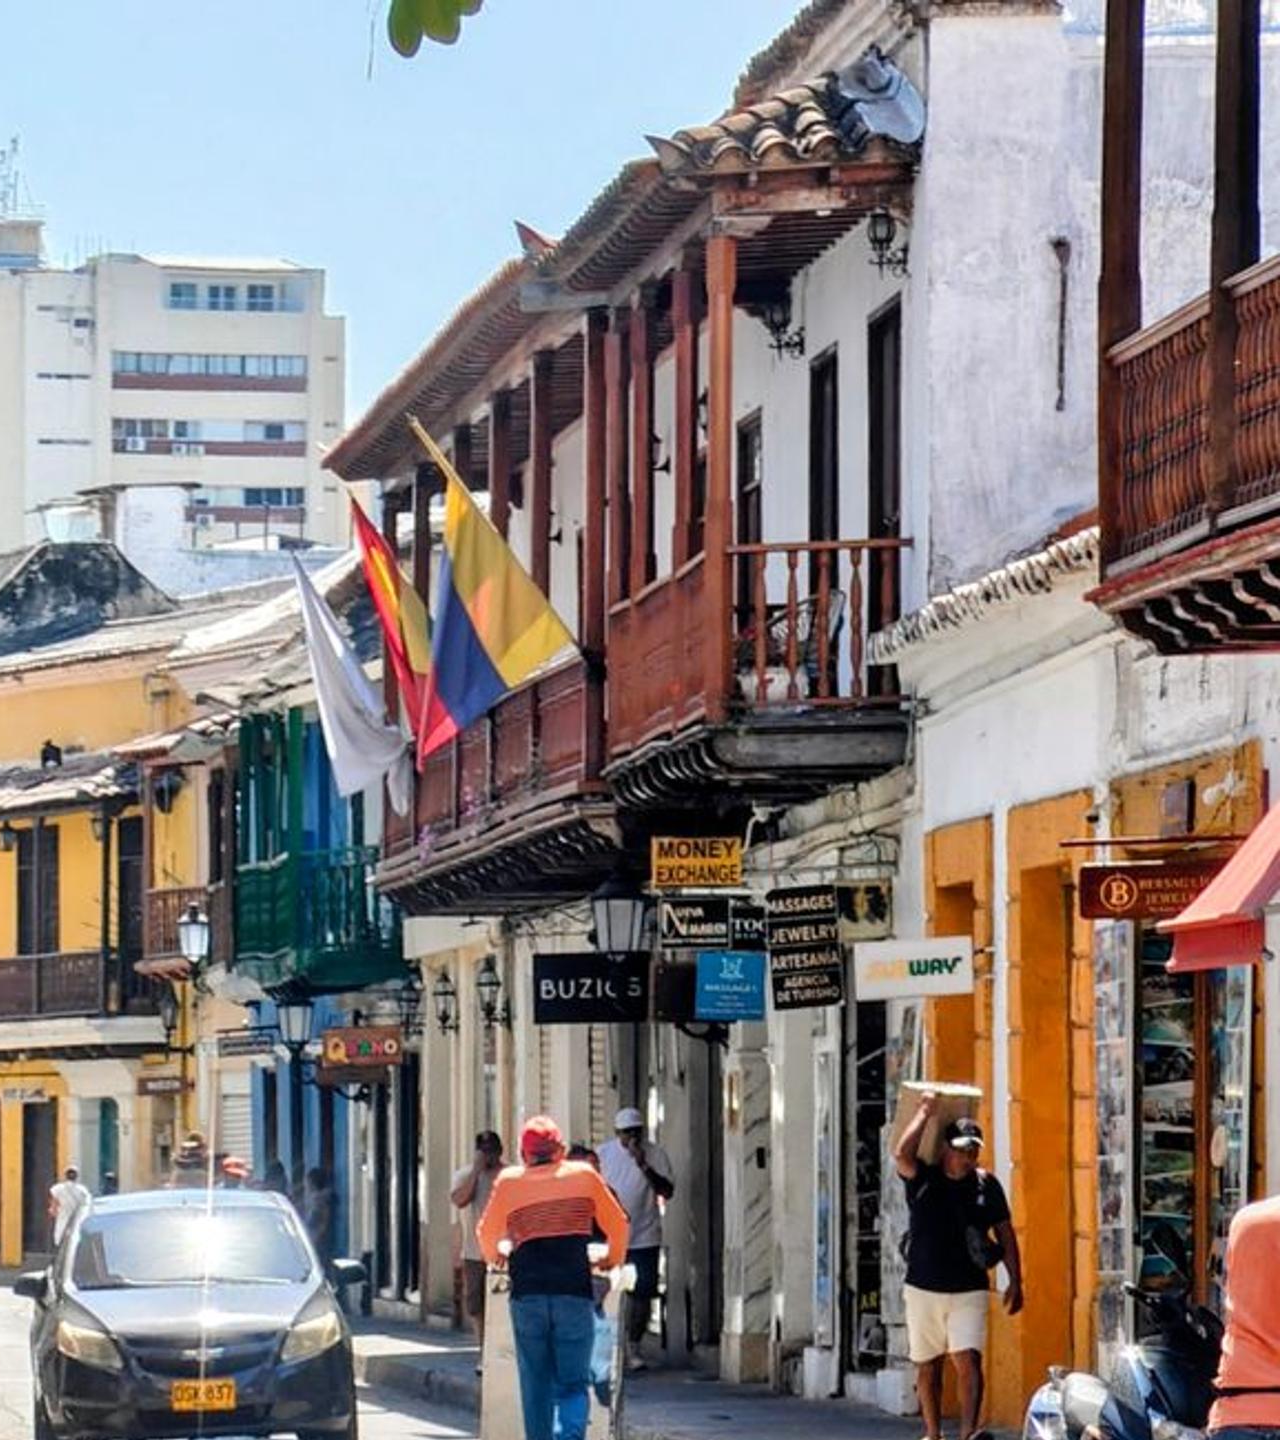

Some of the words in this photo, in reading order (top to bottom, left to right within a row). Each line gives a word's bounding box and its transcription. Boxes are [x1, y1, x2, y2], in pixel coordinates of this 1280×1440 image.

[657, 840, 736, 858] MONEY
[656, 864, 738, 883] EXCHANGE
[767, 894, 834, 913] MASSAGES
[771, 926, 838, 944] JEWELRY
[784, 974, 830, 989] AGENCIA
[777, 990, 791, 1003] DE
[792, 985, 840, 1001] TURISMO
